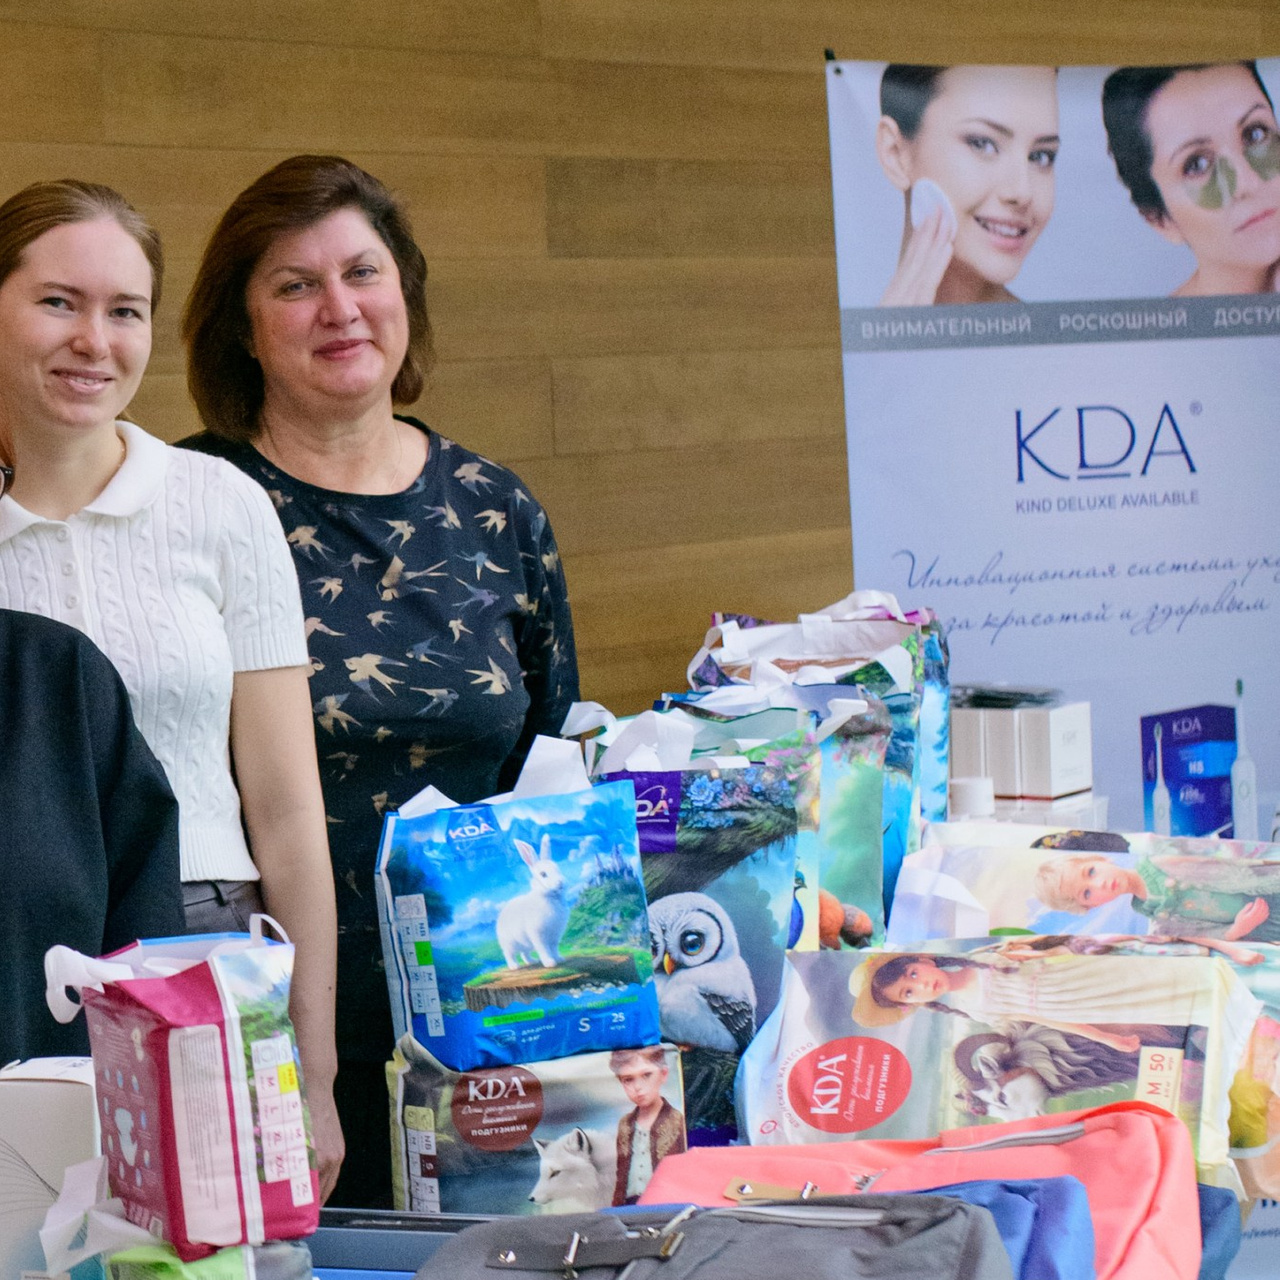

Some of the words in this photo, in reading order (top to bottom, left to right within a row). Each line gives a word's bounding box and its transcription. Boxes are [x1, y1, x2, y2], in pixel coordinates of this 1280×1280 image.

[861, 314, 1032, 340] ВНИМАТЕЛЬНЫЙ
[1059, 309, 1188, 332] РОСКОШНЫЙ
[1015, 402, 1197, 483] KDA
[1015, 497, 1053, 514] KIND
[1056, 494, 1117, 512] DELUXE
[1121, 489, 1200, 508] AVAILABLE
[892, 548, 1117, 595] Инновационная
[1126, 557, 1236, 579] система
[980, 601, 1108, 646] красотой
[1120, 608, 1133, 621] и
[1129, 577, 1269, 636] здоровьем
[635, 799, 670, 818] DA
[448, 821, 495, 839] KDA
[578, 1018, 591, 1032] S
[611, 1012, 626, 1023] 25
[778, 1041, 815, 1078] КАЧЕСТВО
[1149, 1052, 1166, 1071] 50
[468, 1076, 527, 1102] KDA
[810, 1053, 848, 1115] KDA
[874, 1053, 891, 1114] ПОДГУЗНИКИ
[1146, 1081, 1162, 1096] M
[470, 1124, 528, 1136] ПОДГУЗНИКИ
